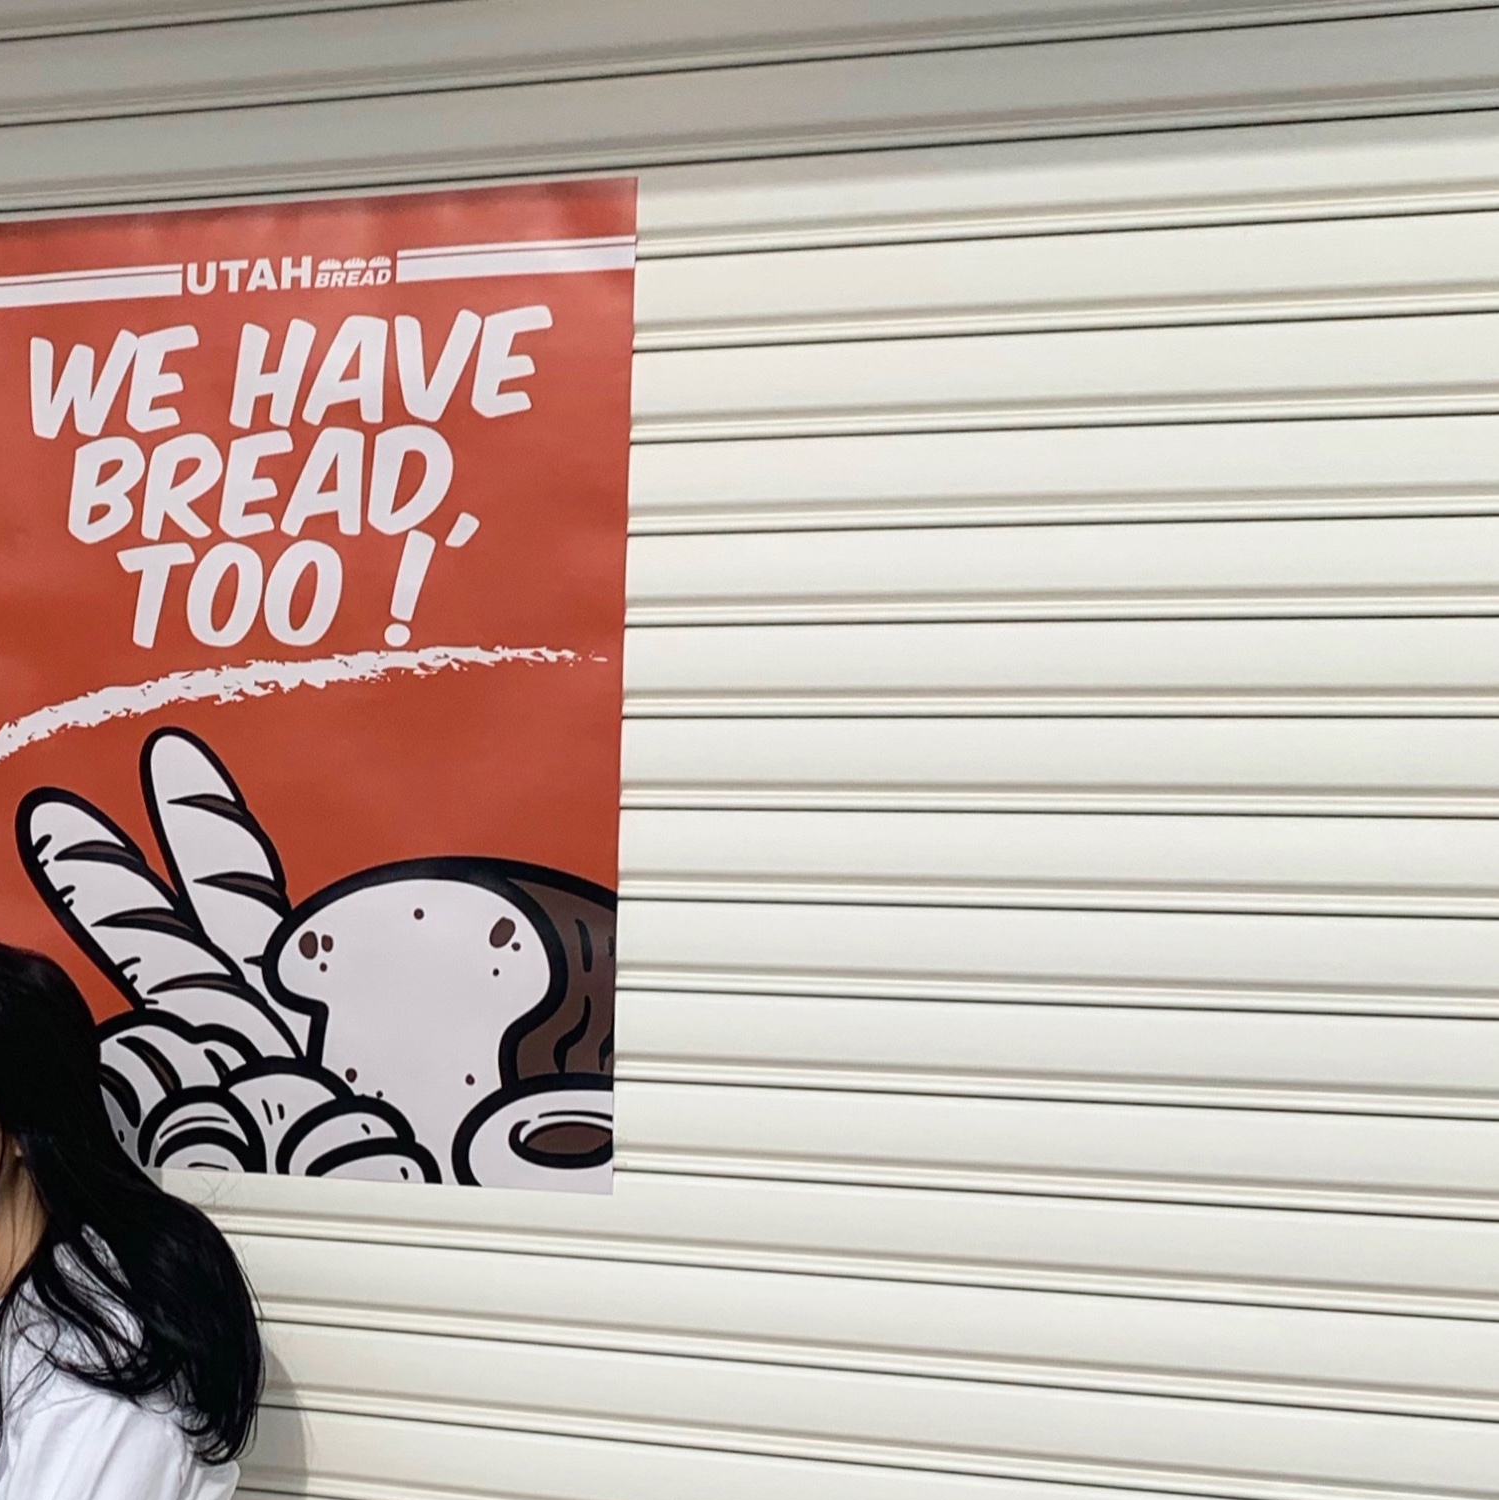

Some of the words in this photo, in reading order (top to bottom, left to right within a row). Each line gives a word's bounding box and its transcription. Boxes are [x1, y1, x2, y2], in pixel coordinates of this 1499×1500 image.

[186, 255, 313, 295] UTAH
[314, 268, 392, 289] BREAD
[29, 324, 199, 439] WE
[229, 304, 554, 429] HAVE
[67, 424, 480, 548] BREAD,
